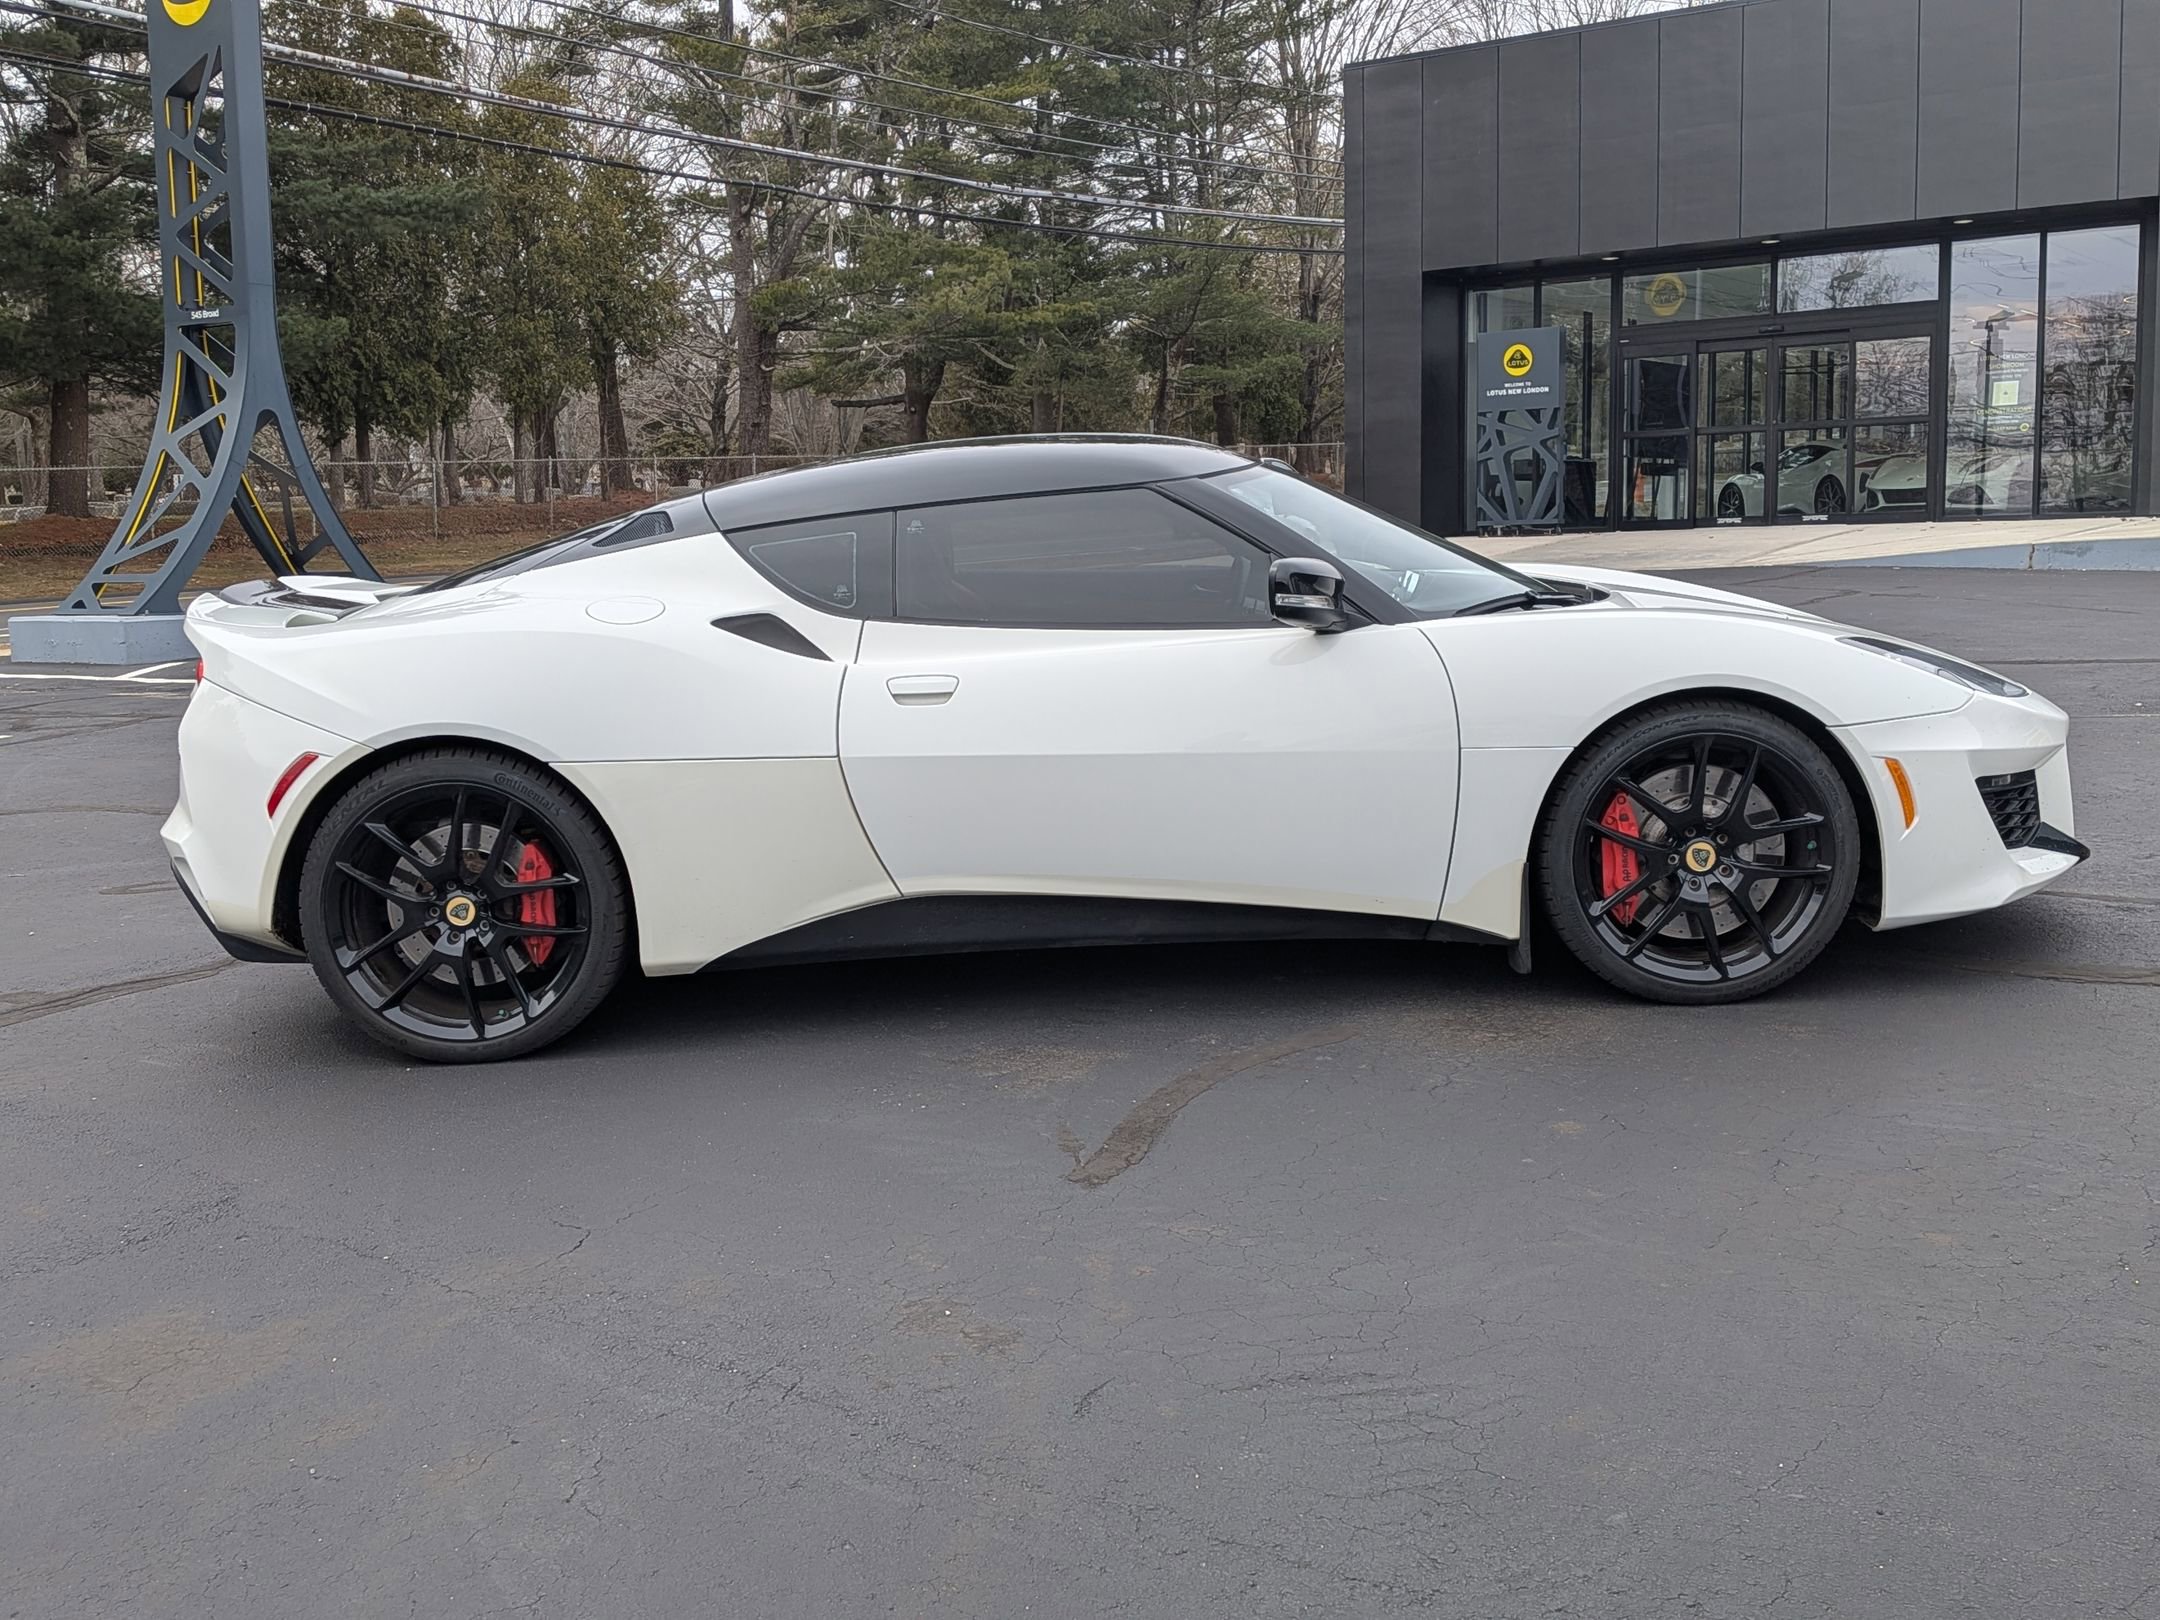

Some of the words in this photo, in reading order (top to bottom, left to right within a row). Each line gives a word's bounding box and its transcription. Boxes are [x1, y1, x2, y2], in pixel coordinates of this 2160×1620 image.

[191, 311, 202, 320] 545
[202, 308, 220, 319] Broad
[1486, 389, 1507, 397] LOTUS
[1523, 386, 1549, 394] LONDON
